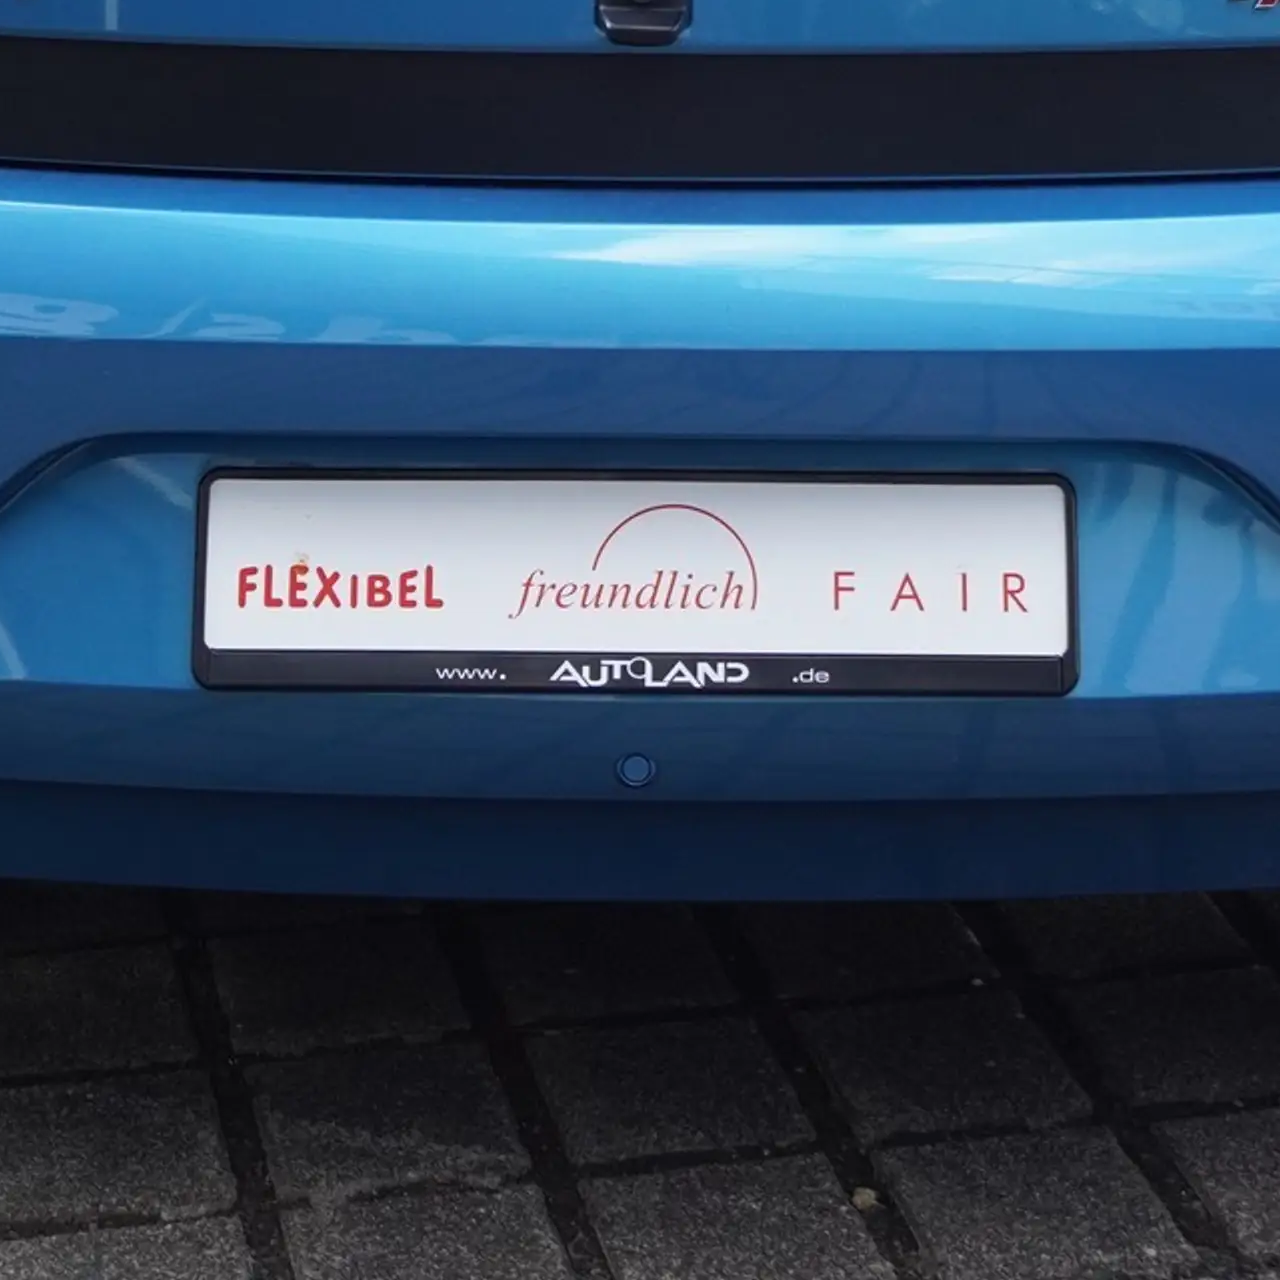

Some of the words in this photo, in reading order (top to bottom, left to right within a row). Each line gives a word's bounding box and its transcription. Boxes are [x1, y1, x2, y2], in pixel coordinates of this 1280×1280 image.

[237, 564, 445, 609] FLEXIBEL
[508, 569, 745, 619] freundlich
[831, 571, 1029, 613] FAIR
[435, 666, 507, 681] www.
[549, 655, 751, 688] AUTOLAND
